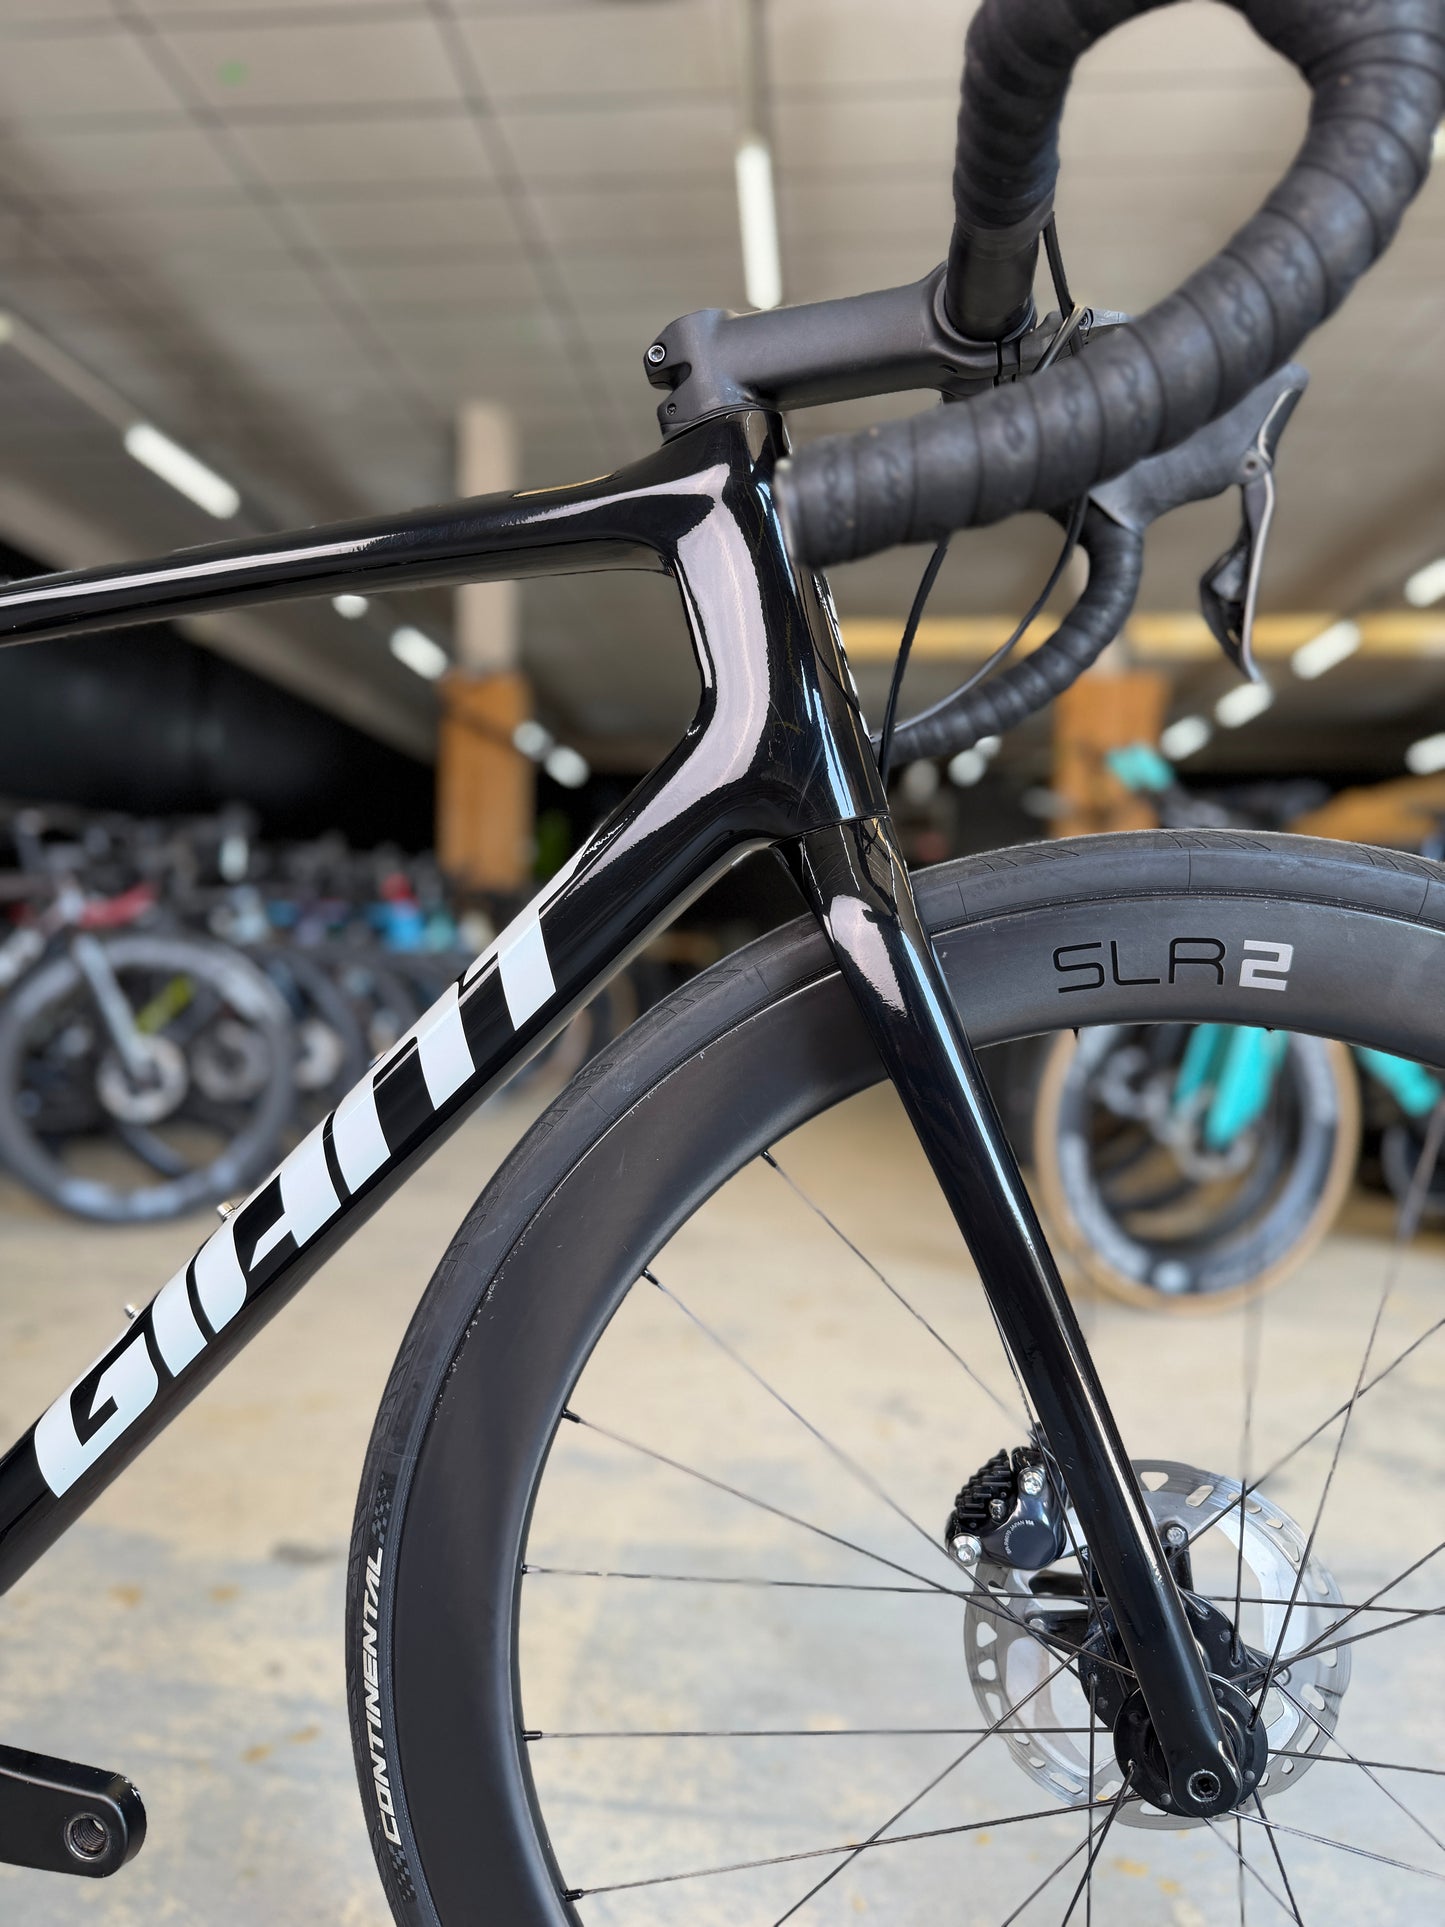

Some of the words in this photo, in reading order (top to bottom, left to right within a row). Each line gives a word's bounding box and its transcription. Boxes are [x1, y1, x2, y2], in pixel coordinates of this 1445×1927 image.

[1052, 937, 1226, 994] SLR
[1238, 939, 1294, 991] 2
[34, 828, 600, 1499] GIANT
[362, 1546, 402, 1846] CONTINENTAL
